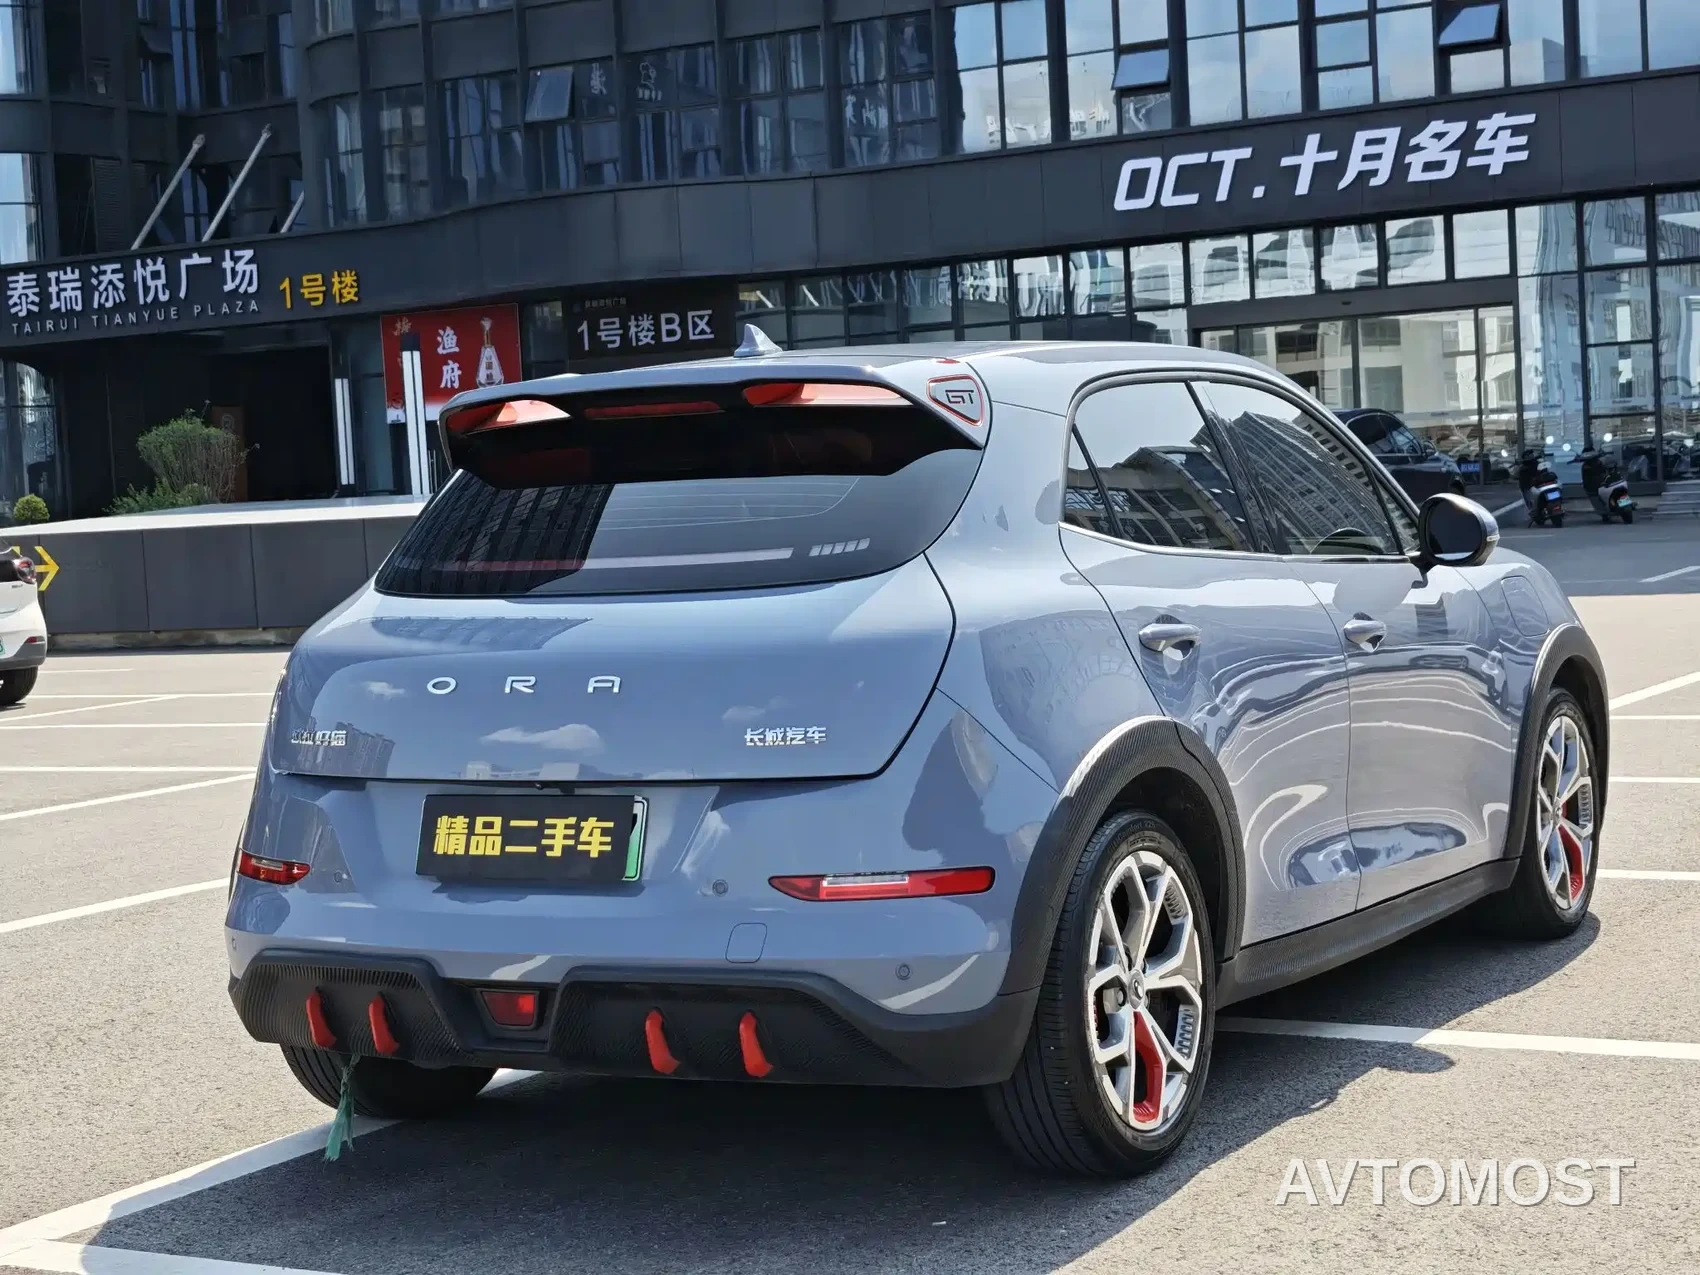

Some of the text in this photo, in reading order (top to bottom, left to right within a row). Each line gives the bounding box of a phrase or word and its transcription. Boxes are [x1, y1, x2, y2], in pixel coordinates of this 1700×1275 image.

[1279, 111, 1537, 197] 十月名车
[6, 249, 260, 318] 泰瑞添悦广场
[278, 269, 360, 310] 1号楼
[11, 299, 260, 336] TAIRUI TIANYUE PLAZA
[577, 309, 715, 351] 1号楼B区
[427, 675, 621, 695] ORA
[744, 726, 828, 746] 长城汽车
[433, 815, 615, 858] 精品二手车
